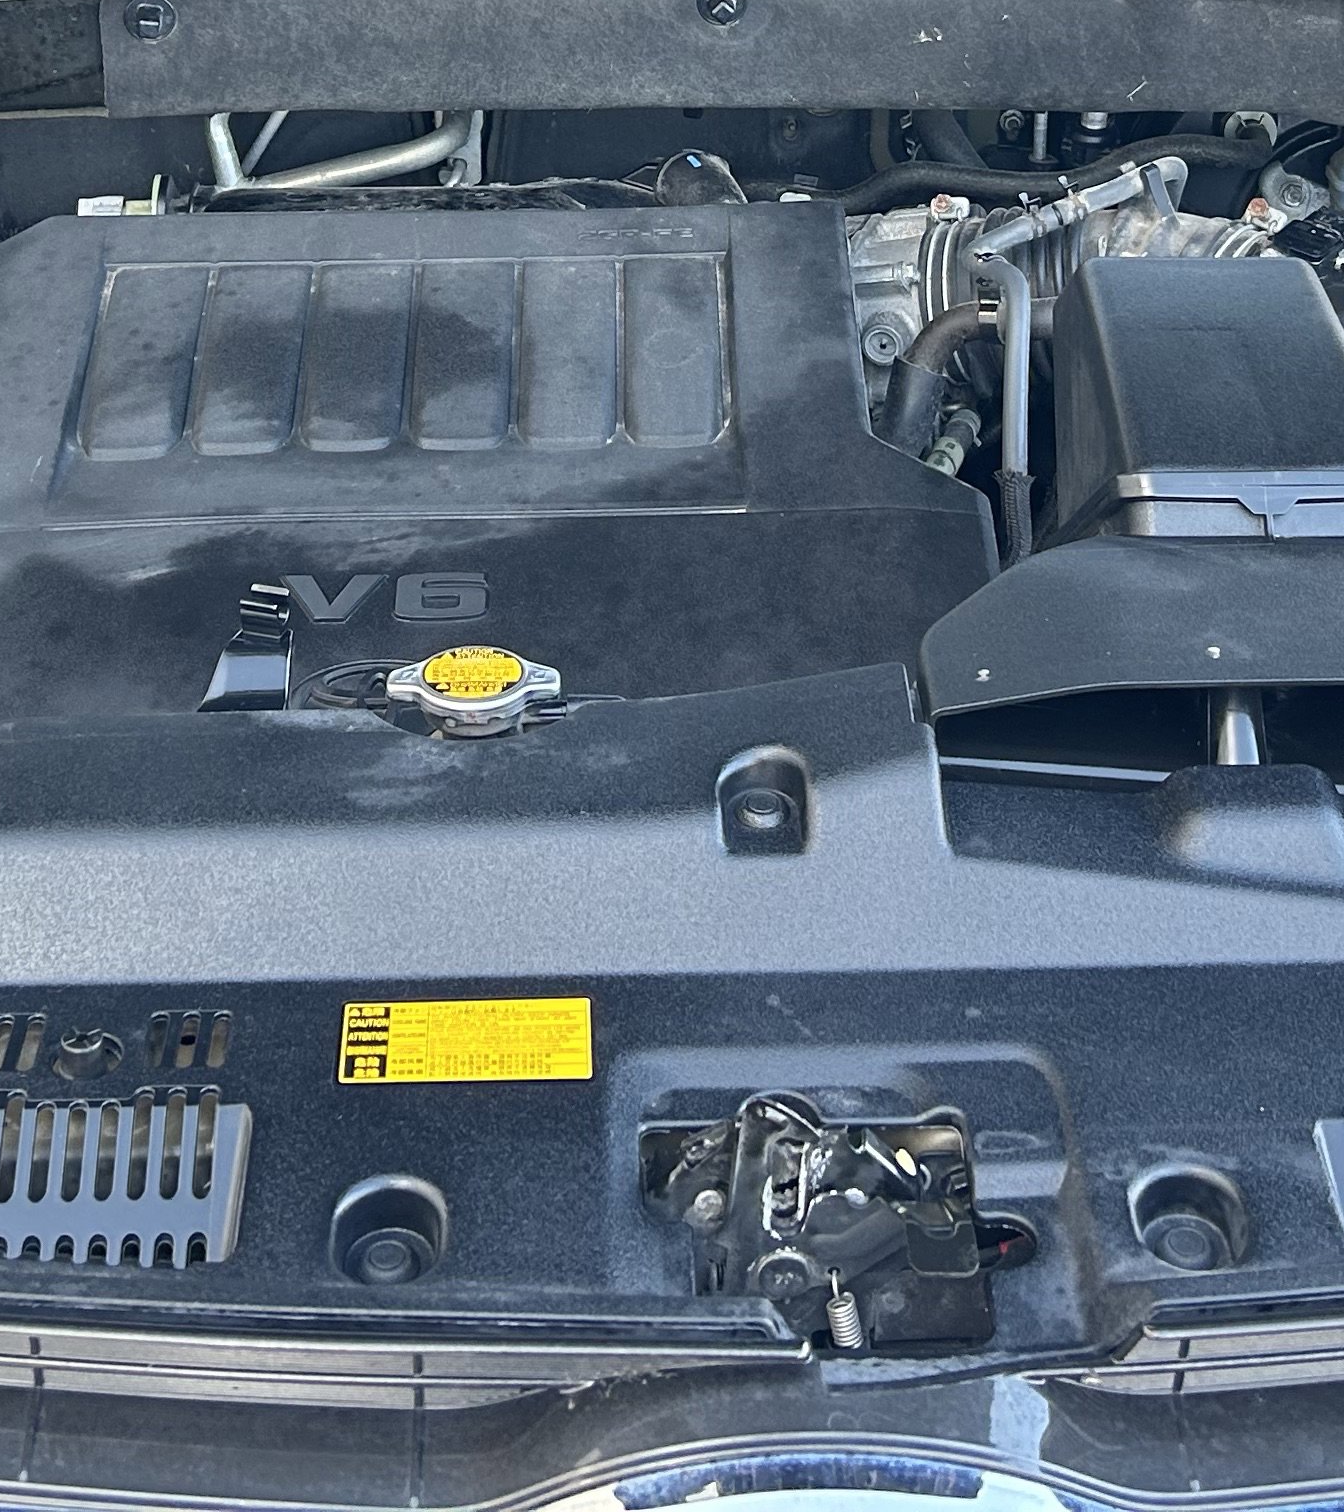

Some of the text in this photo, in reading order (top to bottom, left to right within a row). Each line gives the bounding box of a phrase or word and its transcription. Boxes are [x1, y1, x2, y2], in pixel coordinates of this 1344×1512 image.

[281, 572, 490, 623] V6
[349, 1017, 390, 1028] CAUTION
[348, 1031, 388, 1042] ATTENTION
